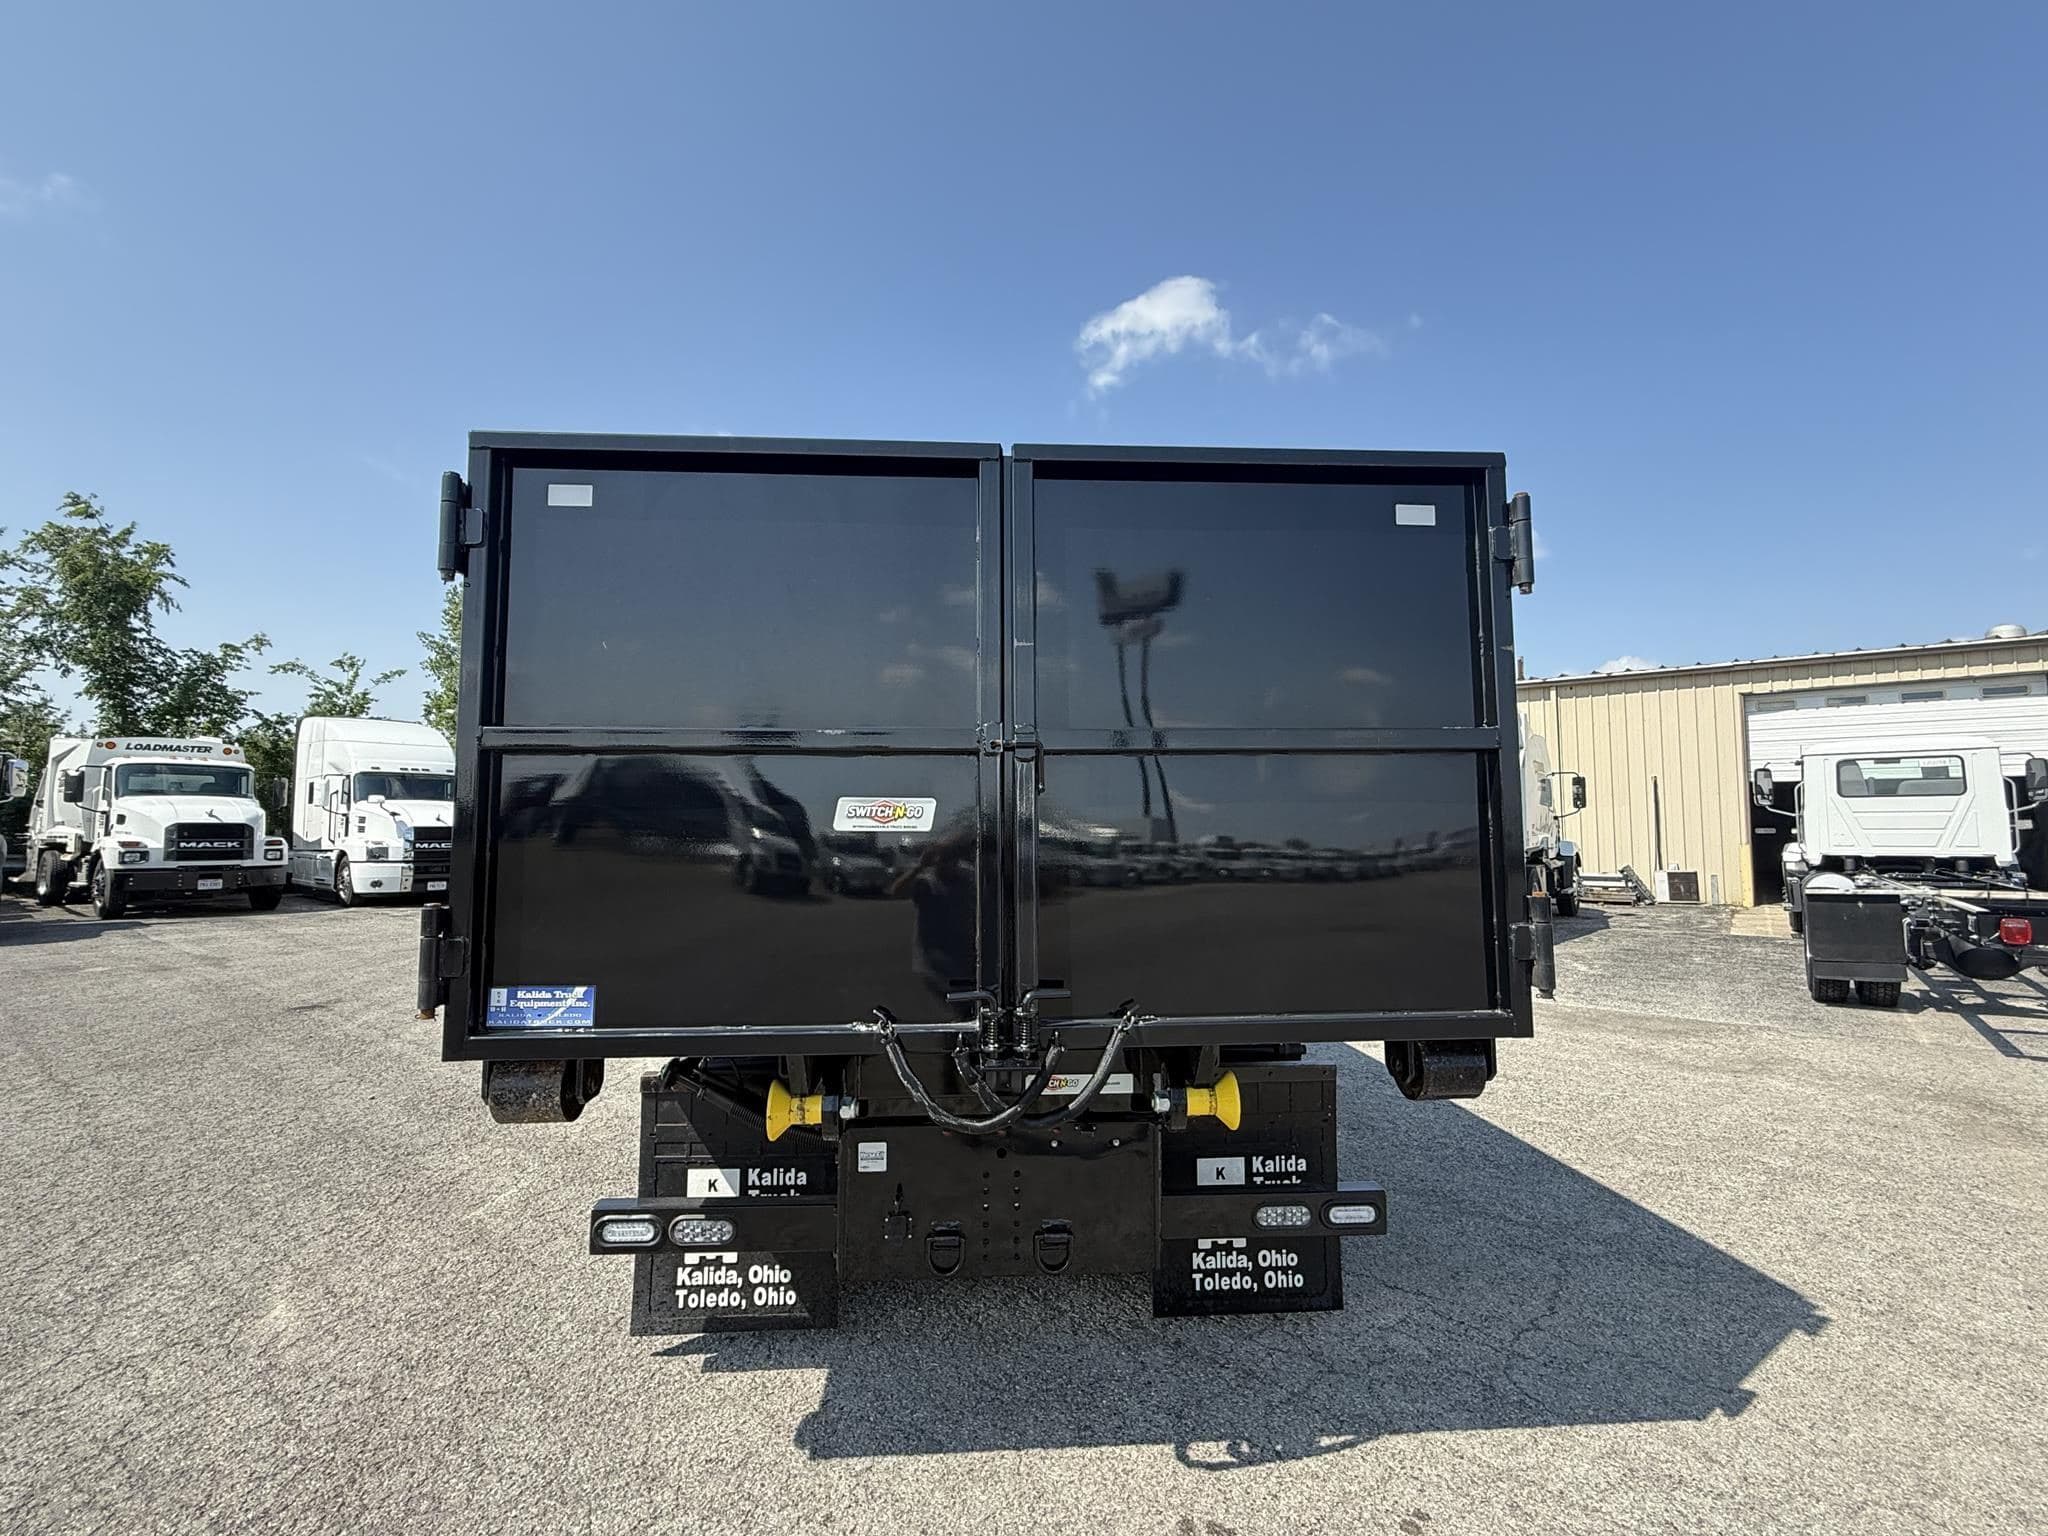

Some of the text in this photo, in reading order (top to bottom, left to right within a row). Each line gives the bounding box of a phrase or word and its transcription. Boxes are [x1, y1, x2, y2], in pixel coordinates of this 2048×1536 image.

[125, 742, 213, 754] LOADMASTER
[516, 990, 552, 999] Kalida
[1215, 1166, 1226, 1180] K
[1252, 1155, 1307, 1173] Kalida
[707, 1178, 719, 1192] K
[747, 1168, 807, 1186] Kalida
[1192, 1249, 1298, 1271] Kalida, Ohio
[676, 1264, 792, 1288] Kalida, Ohio
[1192, 1270, 1304, 1292] Toledo, Ohio
[675, 1287, 797, 1309] Toledo, Ohio
